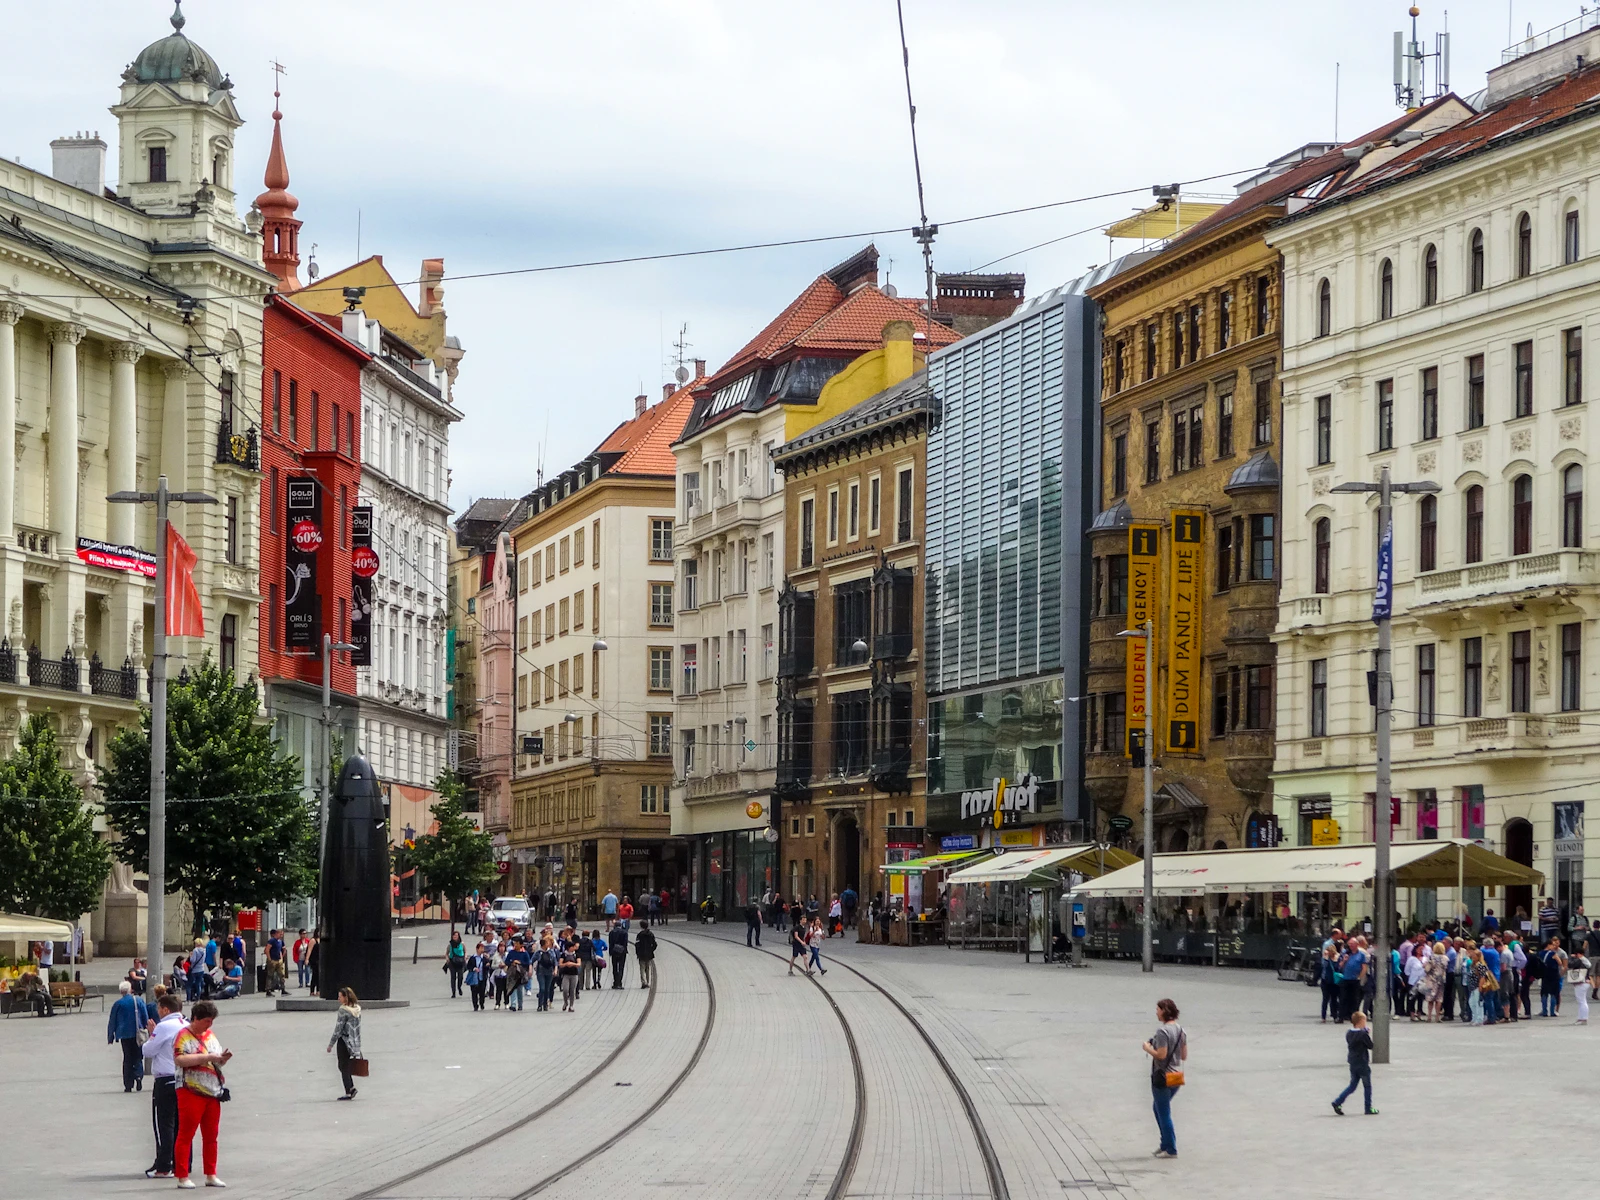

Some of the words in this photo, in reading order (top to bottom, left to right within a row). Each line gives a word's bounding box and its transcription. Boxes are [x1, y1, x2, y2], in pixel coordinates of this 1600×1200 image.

[292, 531, 322, 544] -60%
[1134, 570, 1147, 631] AGENCY
[1178, 593, 1191, 602] Z
[307, 614, 313, 623] 3
[362, 635, 368, 643] 3
[1174, 611, 1191, 660] PÁNŮ
[1133, 643, 1146, 714] STUDENT
[1173, 670, 1190, 713] DŮM
[748, 804, 759, 813] 24
[1555, 842, 1584, 852] KLENOTY
